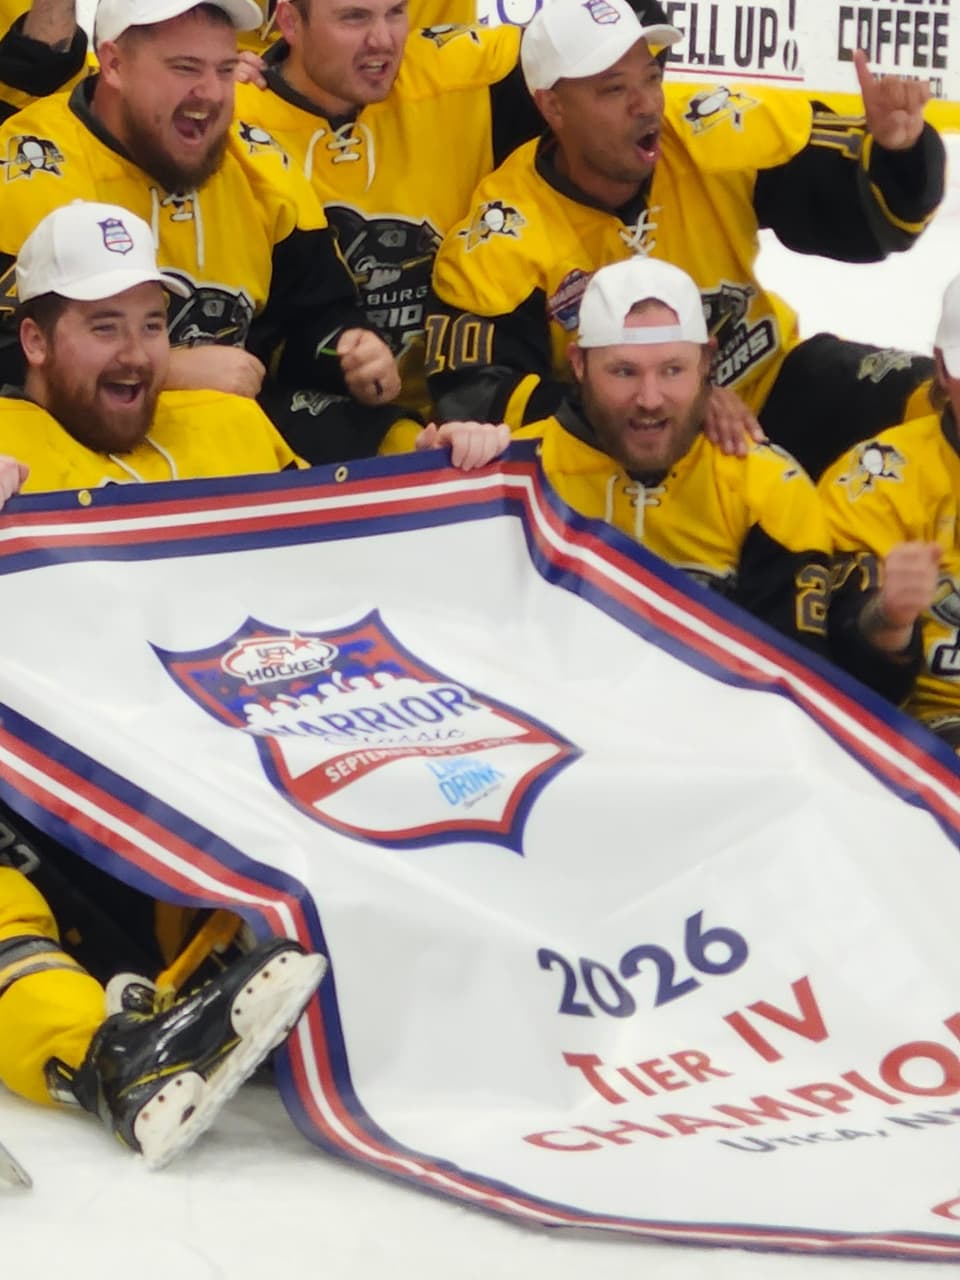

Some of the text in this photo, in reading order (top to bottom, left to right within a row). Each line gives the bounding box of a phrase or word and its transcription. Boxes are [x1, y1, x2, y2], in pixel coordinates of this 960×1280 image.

[660, 1, 725, 66] ELL
[838, 6, 949, 69] COFFEE
[247, 657, 326, 681] HOCKEY
[536, 909, 749, 1018] 2026
[522, 1012, 960, 1152] CHAMPIO
[562, 976, 829, 1105] TIER IV
